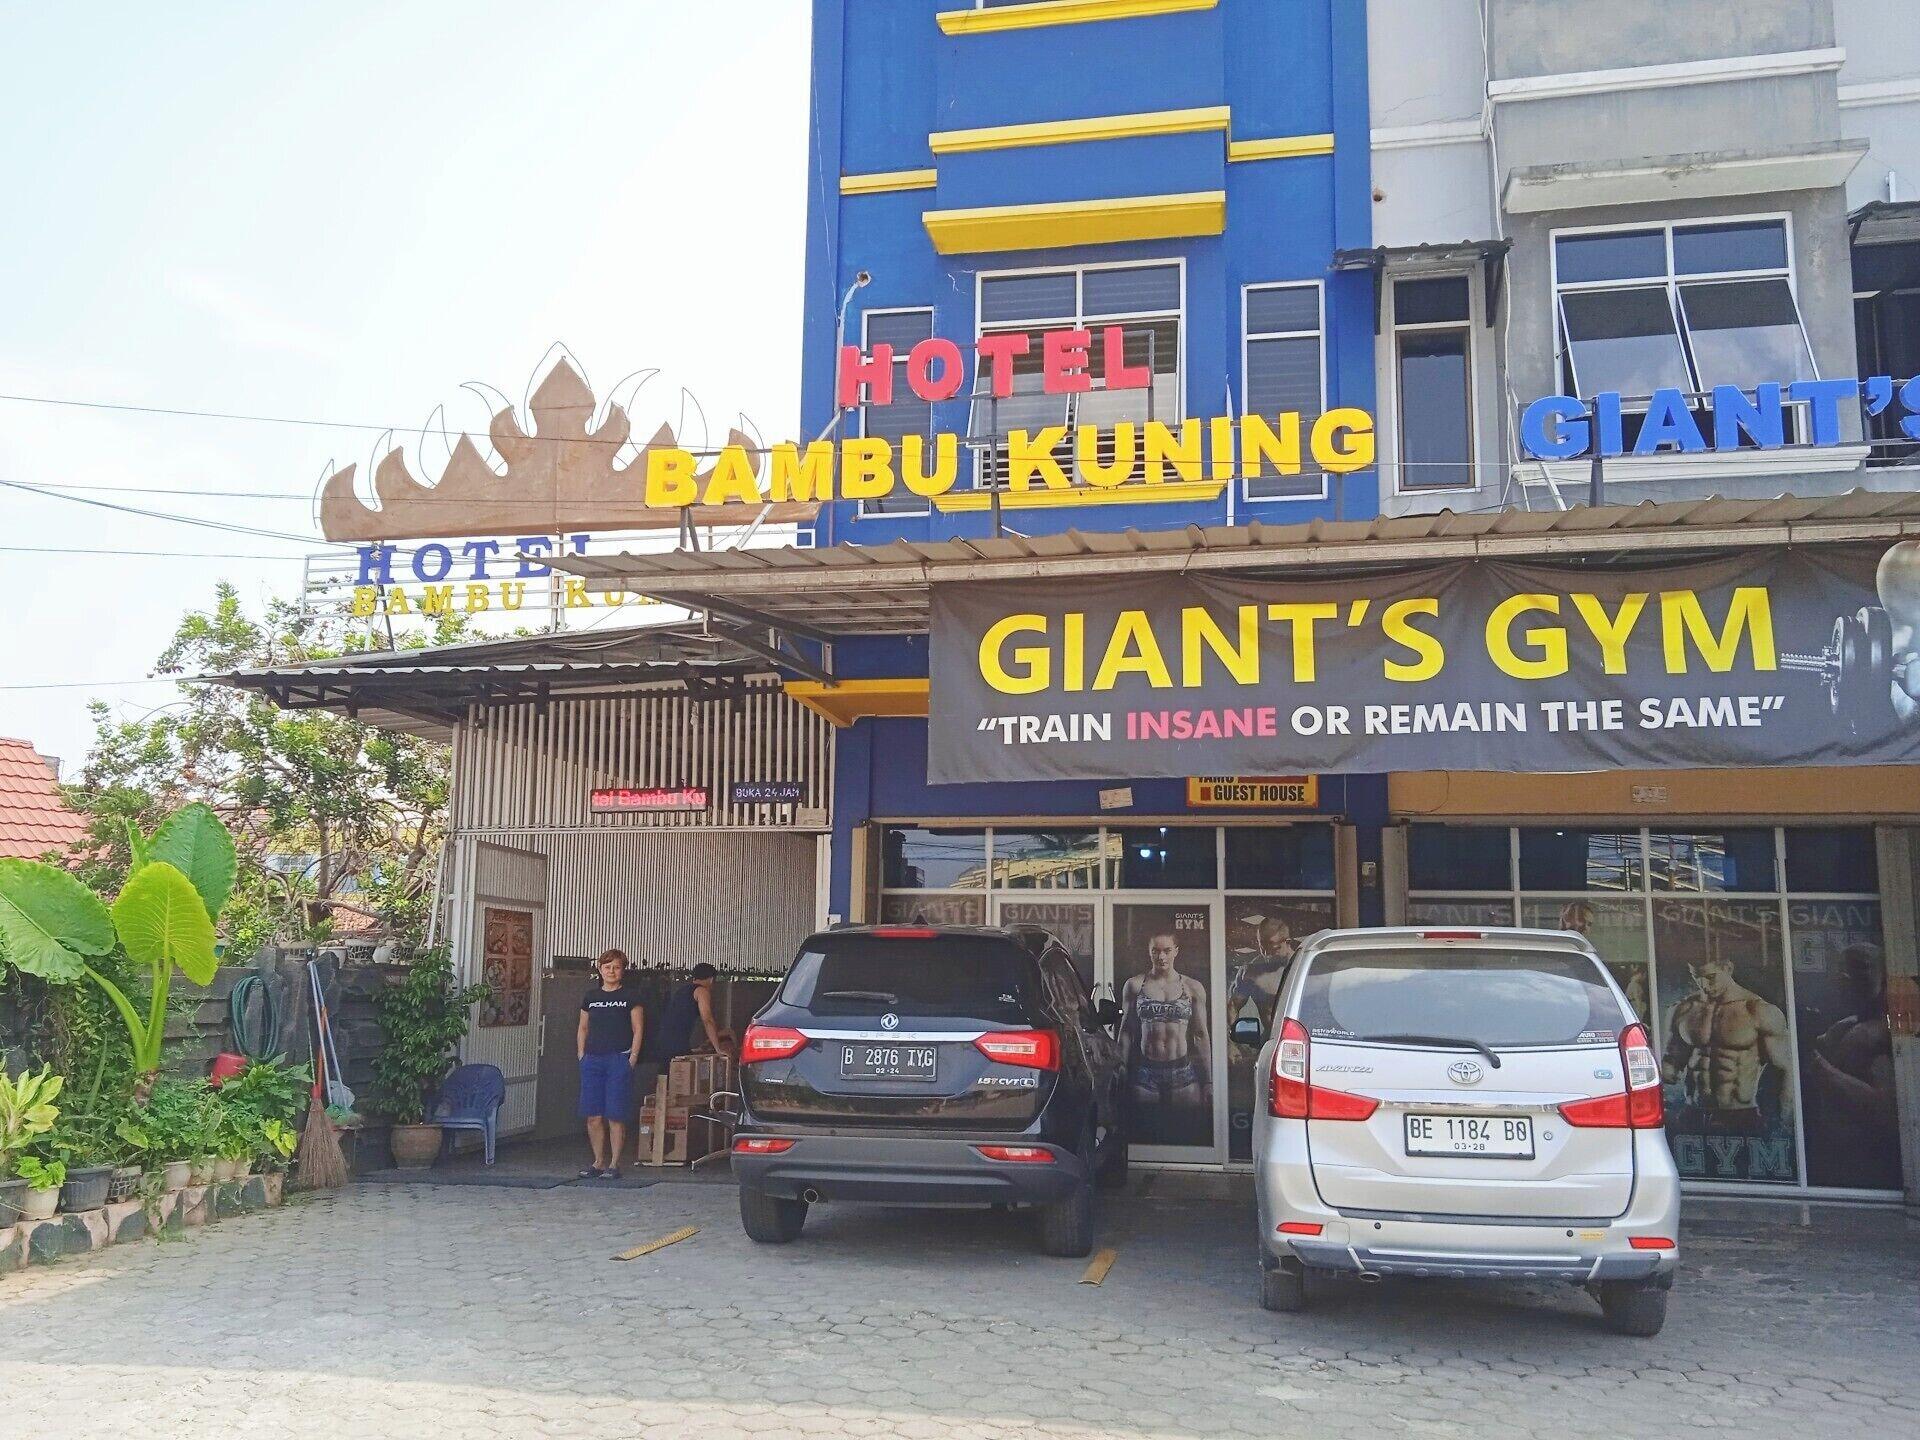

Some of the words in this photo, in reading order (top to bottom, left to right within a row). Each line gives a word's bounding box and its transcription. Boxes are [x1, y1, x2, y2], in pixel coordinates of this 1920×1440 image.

[840, 326, 1151, 407] HOTEL
[646, 433, 957, 508] BAMBU
[1008, 408, 1375, 491] KUNING
[353, 582, 526, 617] BAMBU
[978, 598, 1445, 695] GIANT'S
[1486, 587, 1777, 681] GYM
[1127, 707, 1277, 741] INSANE
[1290, 705, 1350, 736] OR
[1365, 702, 1527, 735] REMAIN
[1540, 698, 1624, 732] THE
[736, 788, 761, 798] BUKA
[764, 788, 778, 798] 24
[779, 787, 800, 797] JAM
[1214, 785, 1256, 801] GUEST
[1259, 785, 1304, 801] HOUSE
[1175, 919, 1205, 930] GYM
[844, 1048, 854, 1065] B
[865, 1048, 899, 1066] 2876
[1316, 1064, 1374, 1074] AVANZA
[1410, 1118, 1432, 1140] BE
[1446, 1119, 1491, 1141] 1184
[1675, 1134, 1792, 1177] GYM
